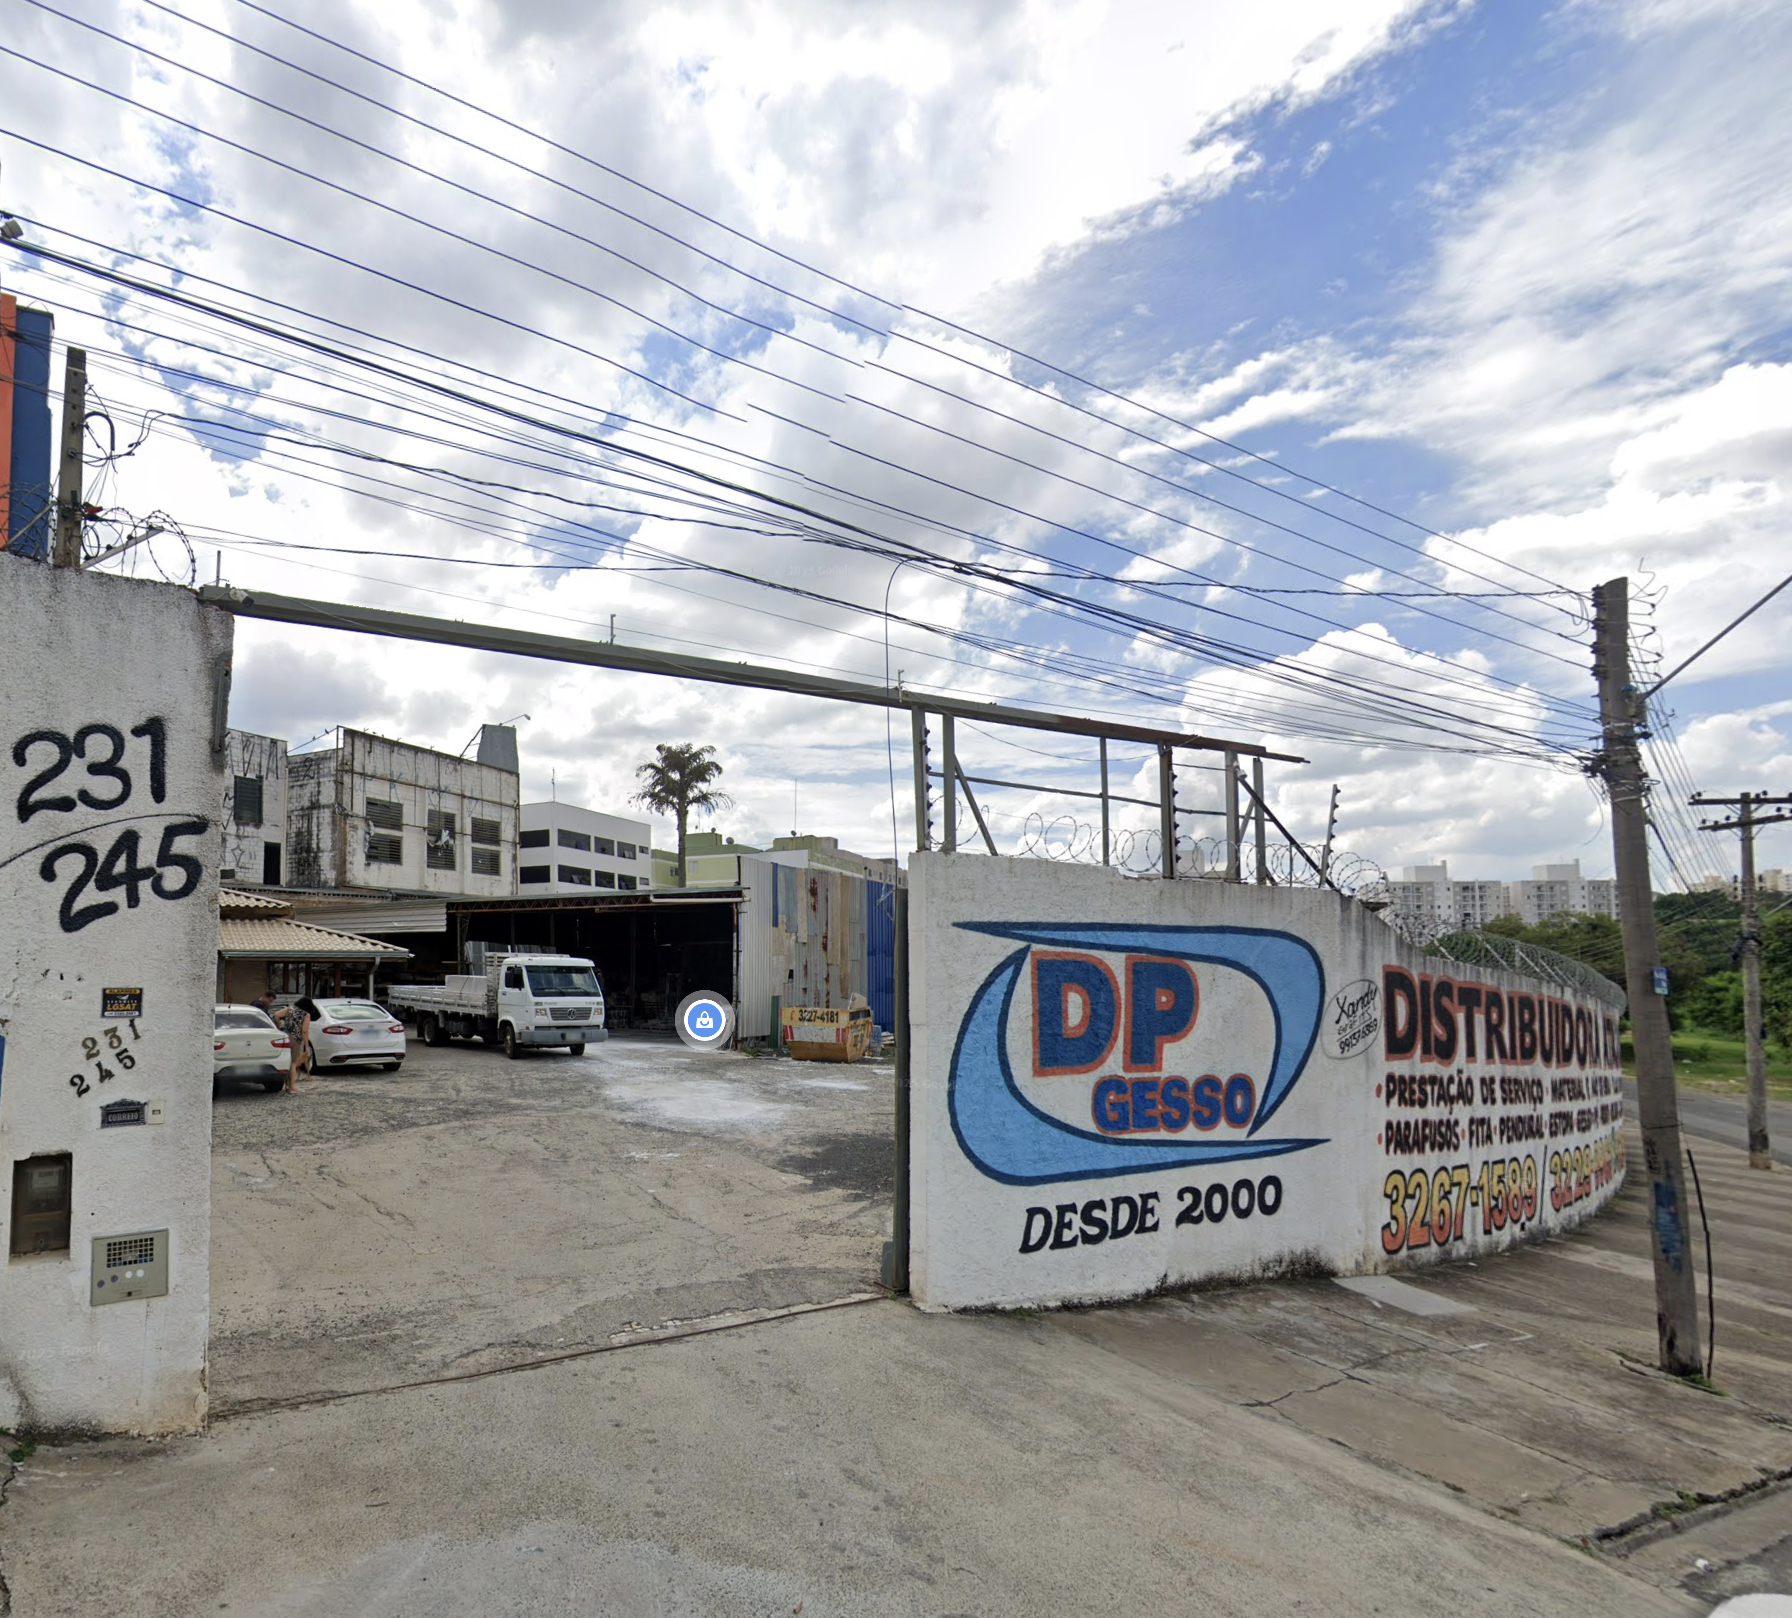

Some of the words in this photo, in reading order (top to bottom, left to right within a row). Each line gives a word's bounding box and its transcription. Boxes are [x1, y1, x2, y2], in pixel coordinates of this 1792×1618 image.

[13, 715, 167, 824] 231
[39, 819, 209, 934] 245
[106, 1003, 137, 1011] LGSAT
[798, 1009, 839, 1024] 3227-4181
[1030, 950, 1200, 1078] DP
[81, 1018, 141, 1061] 231
[69, 1047, 136, 1098] 245
[1384, 1069, 1475, 1115] PRESTAÇÃO
[1480, 1076, 1497, 1106] DE
[1499, 1076, 1544, 1112] SERVIÇO
[107, 1111, 140, 1122] CORREIO
[1091, 1072, 1256, 1136] GESSO
[1385, 1118, 1460, 1156] PARAFUSOS
[1468, 1115, 1494, 1149] FITA
[1018, 1190, 1161, 1254] DESDE
[1175, 1175, 1282, 1229] 2000
[1381, 1153, 1537, 1256] 3267-1589
